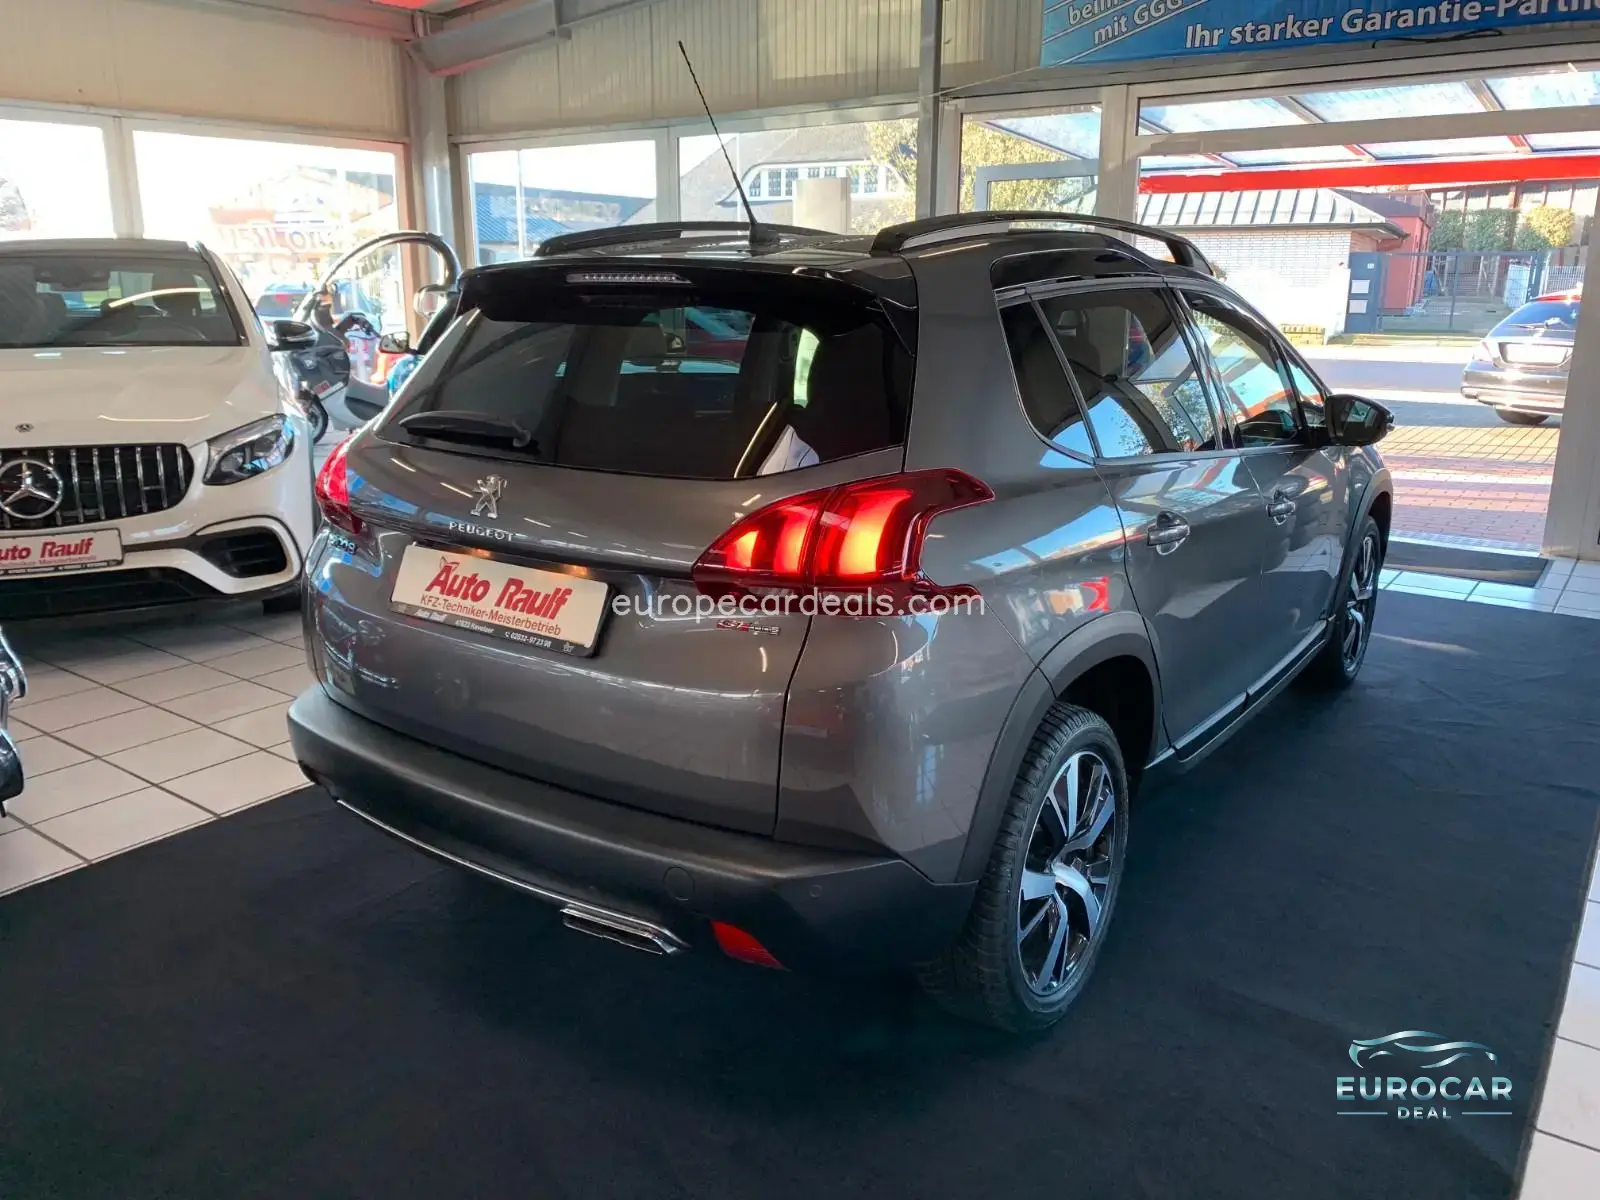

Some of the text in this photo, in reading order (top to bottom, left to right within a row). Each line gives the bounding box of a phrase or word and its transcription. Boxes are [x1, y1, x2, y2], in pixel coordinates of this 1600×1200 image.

[1094, 0, 1182, 45] mit GGG
[1185, 0, 1600, 48] Ihr starker Garantie-Partn
[0, 545, 32, 561] uto
[40, 537, 94, 558] Raulf
[449, 521, 515, 541] PEUGEOT
[425, 564, 573, 620] Auto Raulf
[420, 596, 562, 636] KFZ-Techniker-Meisterbetrieb
